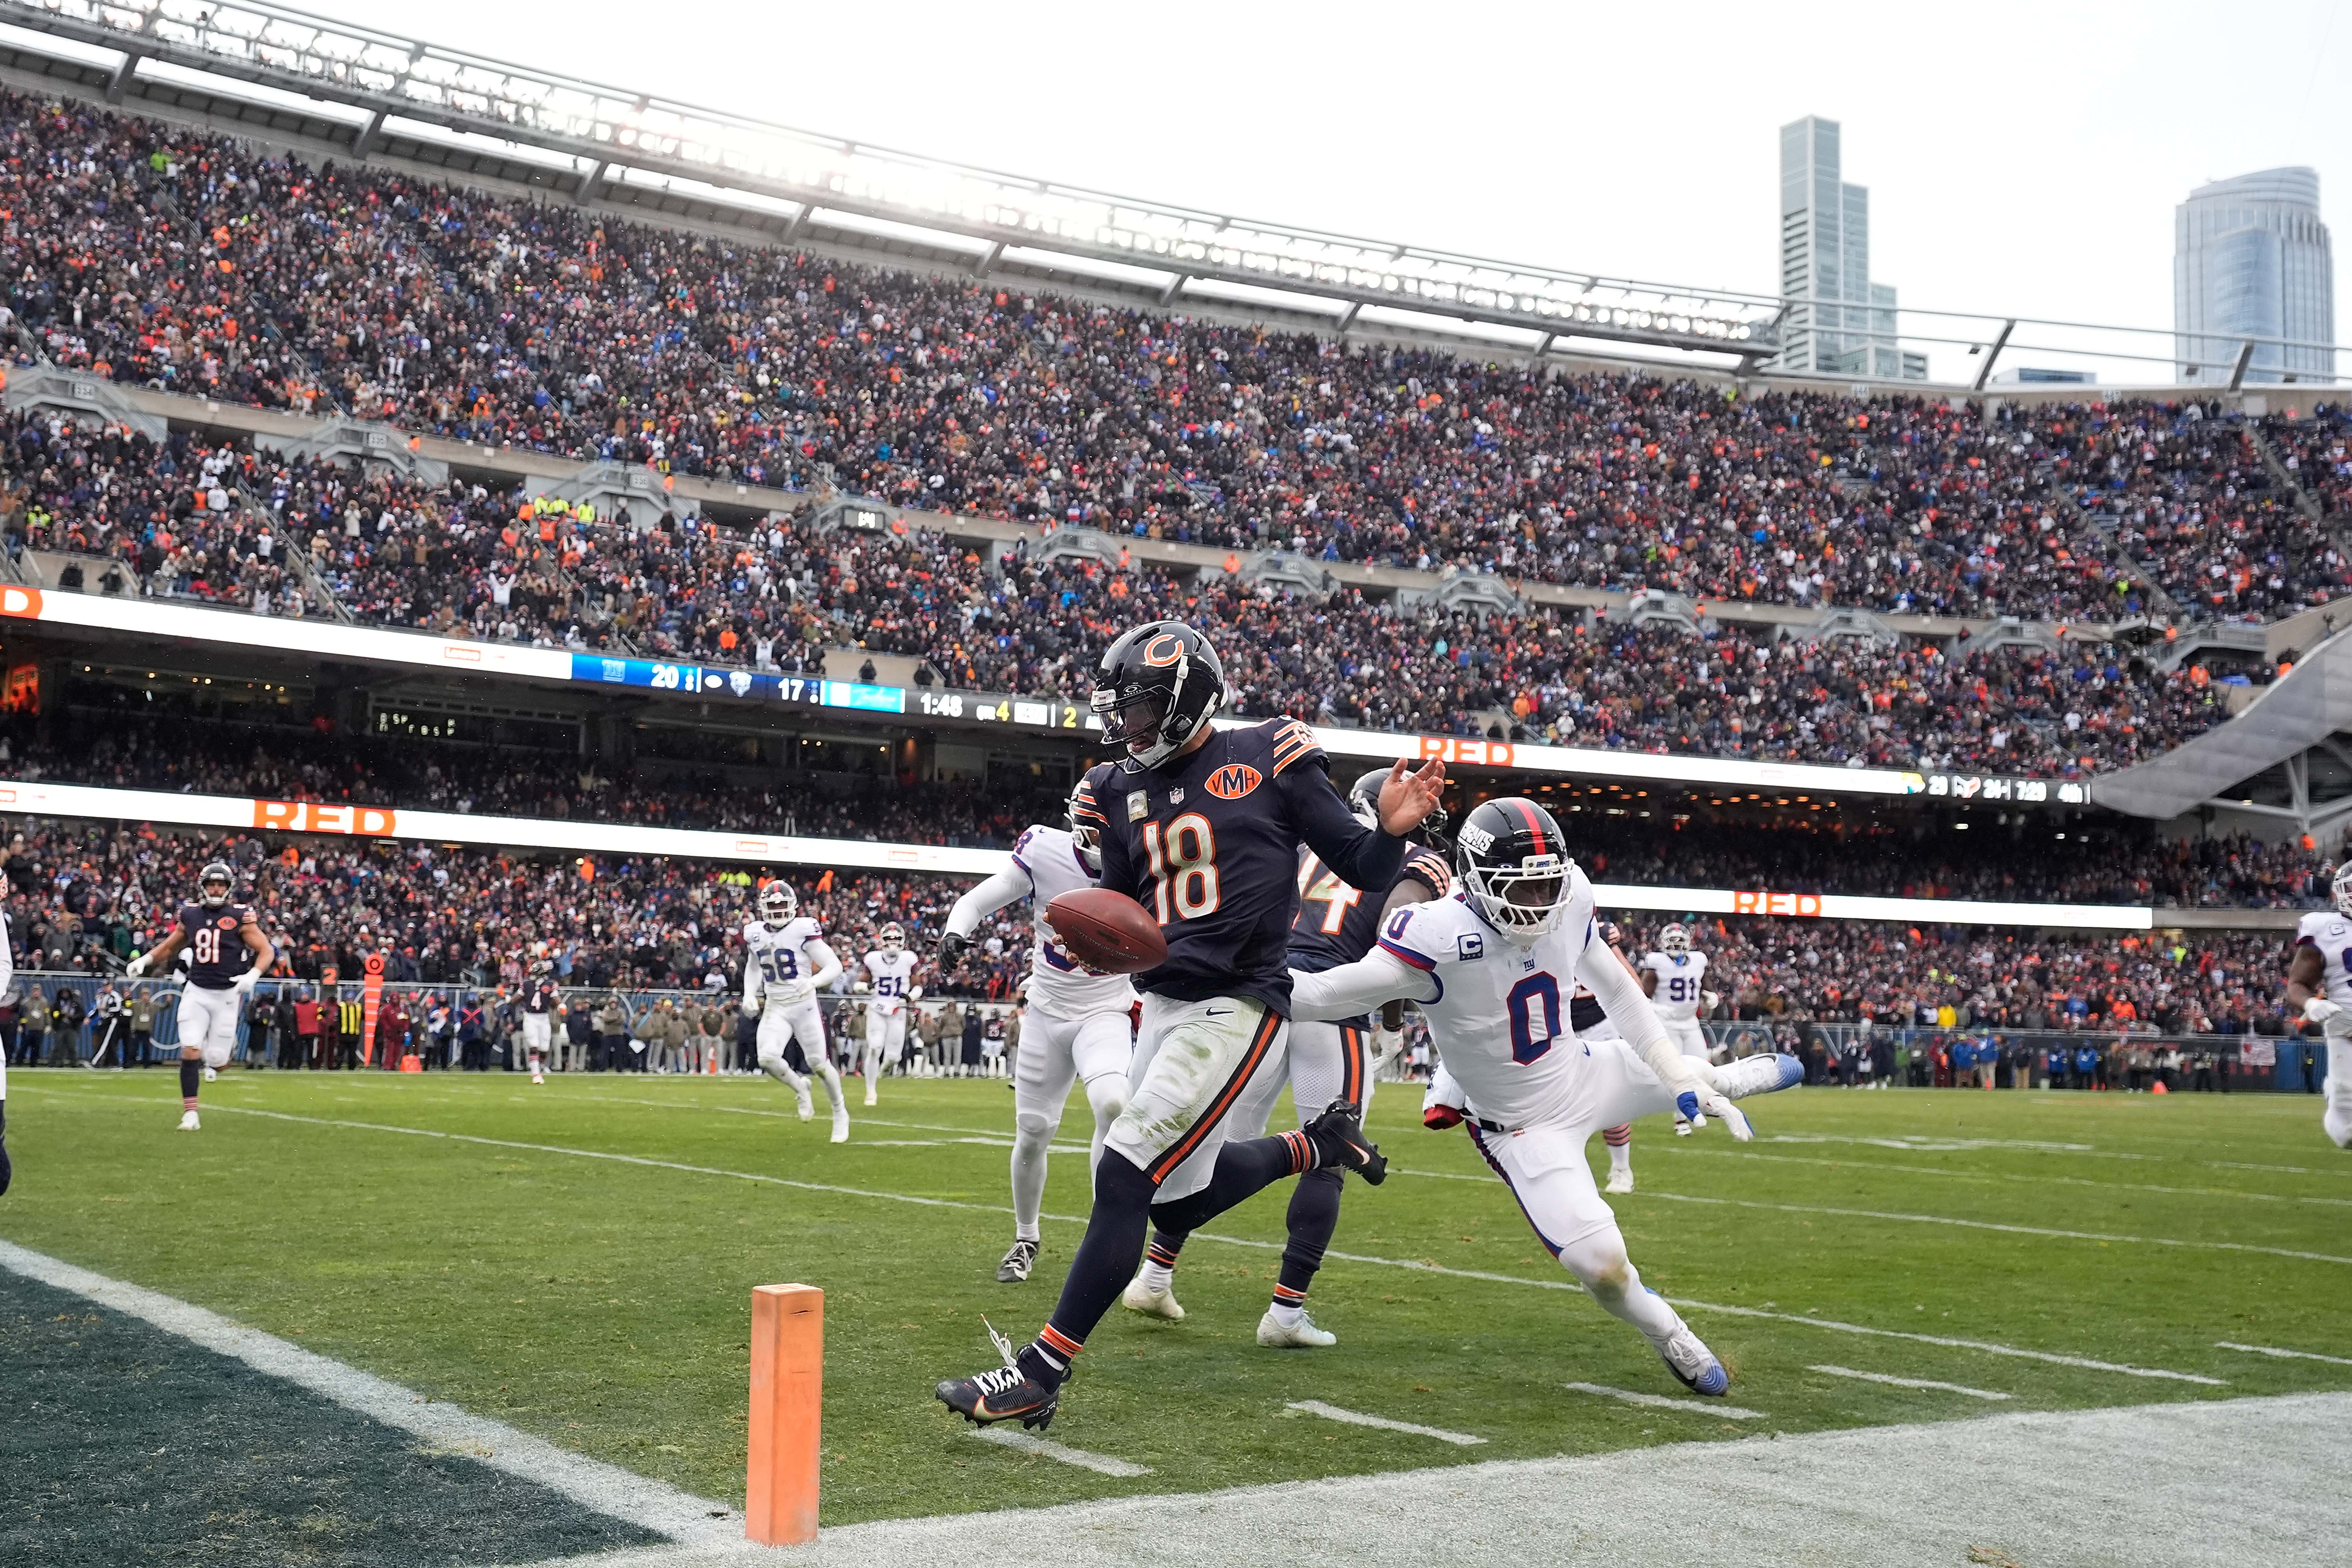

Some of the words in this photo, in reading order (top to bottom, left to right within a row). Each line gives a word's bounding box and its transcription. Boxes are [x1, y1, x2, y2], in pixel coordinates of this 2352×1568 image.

[651, 664, 680, 689] 20
[778, 678, 804, 701] 17
[920, 692, 963, 717] 1:48
[996, 701, 1010, 722] 4
[1063, 707, 1077, 728] 2
[1419, 737, 1515, 767] RED
[253, 799, 396, 837] RED
[1143, 812, 1220, 926] 18
[1292, 847, 1363, 935] 4
[1734, 891, 1822, 916] RED
[1387, 909, 1414, 940] 0
[195, 928, 221, 964] 81
[1115, 950, 1140, 960] NATIONAL
[1460, 934, 1483, 954] C
[322, 967, 338, 985] 2
[757, 949, 798, 982] 58
[530, 991, 542, 1010] 4
[878, 976, 901, 996] 51
[1670, 978, 1695, 1001] 91
[1506, 971, 1562, 1065] 0
